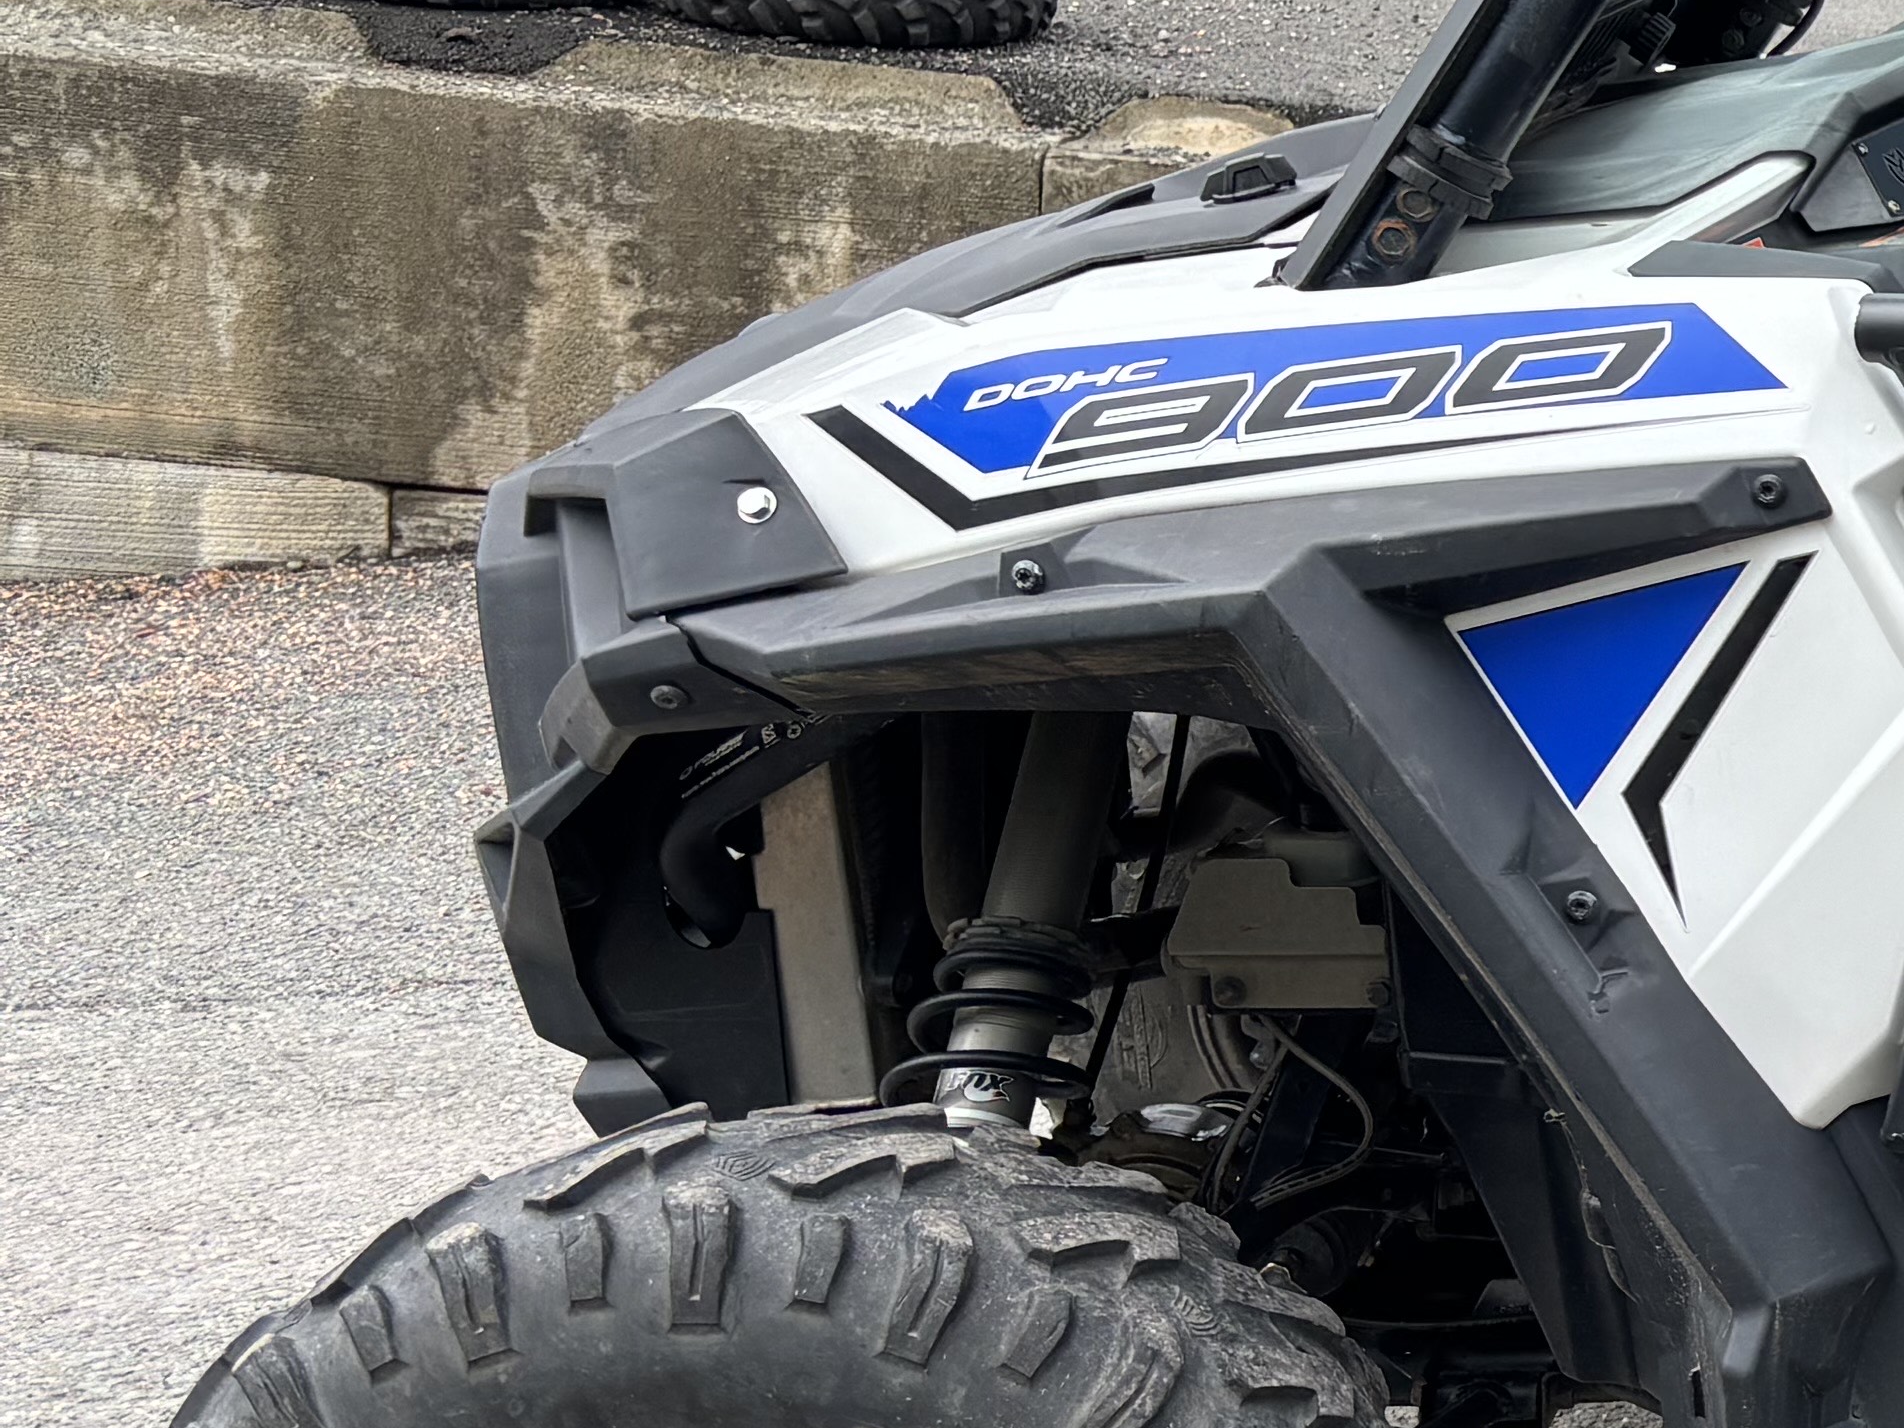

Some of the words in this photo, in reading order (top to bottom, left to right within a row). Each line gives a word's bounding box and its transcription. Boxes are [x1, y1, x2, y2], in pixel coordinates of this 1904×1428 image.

[962, 357, 1169, 412] DOHC
[1023, 319, 1672, 479] 900
[943, 1070, 1014, 1096] FOX
